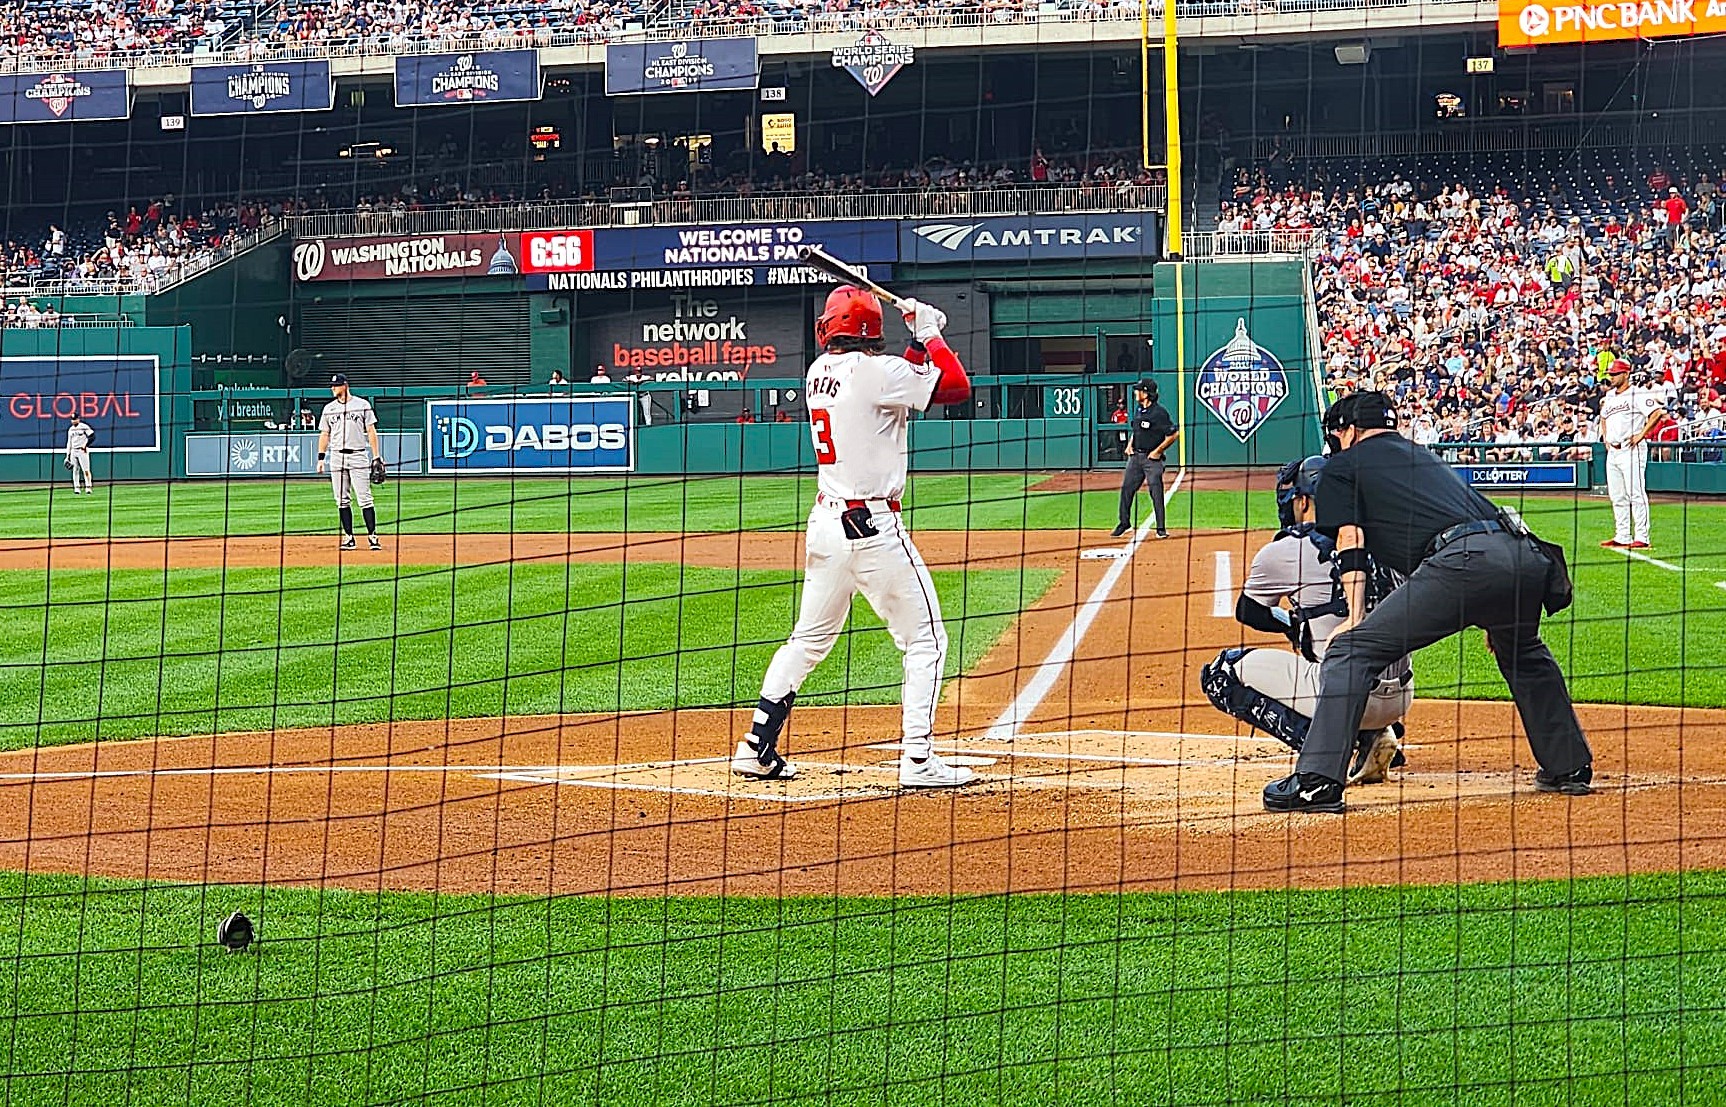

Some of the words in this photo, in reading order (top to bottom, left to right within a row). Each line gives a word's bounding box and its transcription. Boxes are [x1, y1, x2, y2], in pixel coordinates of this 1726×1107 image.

[1552, 4, 1617, 32] PNC
[1620, 0, 1698, 28] BANK
[832, 54, 914, 67] CHAMPIONS
[833, 47, 872, 56] WORLD
[874, 46, 914, 54] SERIES
[644, 64, 714, 78] CHAMPIONS
[678, 57, 707, 66] DIVISION
[1472, 60, 1489, 70] 137
[25, 86, 91, 98] CHAMPIONS
[228, 76, 290, 98] CHAMPIONS
[432, 74, 499, 94] CHAMPIONS
[766, 90, 782, 98] 138
[165, 118, 180, 127] 139
[678, 229, 772, 246] WELCOME
[776, 227, 803, 243] TO
[973, 227, 1136, 246] AMTRAK
[332, 238, 444, 265] WASHINGTON
[530, 236, 580, 267] 6:56
[665, 246, 770, 264] NATIONALS
[386, 250, 482, 276] NATIONALS
[548, 270, 627, 290] NATIONALS
[631, 268, 753, 288] PHILANTHROPIES
[768, 264, 868, 284] #NATS4D
[670, 293, 718, 318] The
[643, 316, 746, 342] network
[614, 341, 718, 366] baseball
[722, 341, 776, 364] fans
[706, 370, 738, 382] on
[1214, 368, 1270, 382] WORLD
[1200, 382, 1284, 398] CHAMPIONS
[9, 390, 140, 418] GLOBAL
[1053, 388, 1081, 415] 335
[218, 405, 235, 422] yu
[236, 401, 274, 418] breathe.
[485, 424, 626, 450] DABOS
[811, 408, 837, 464] 3
[262, 446, 300, 463] RTX
